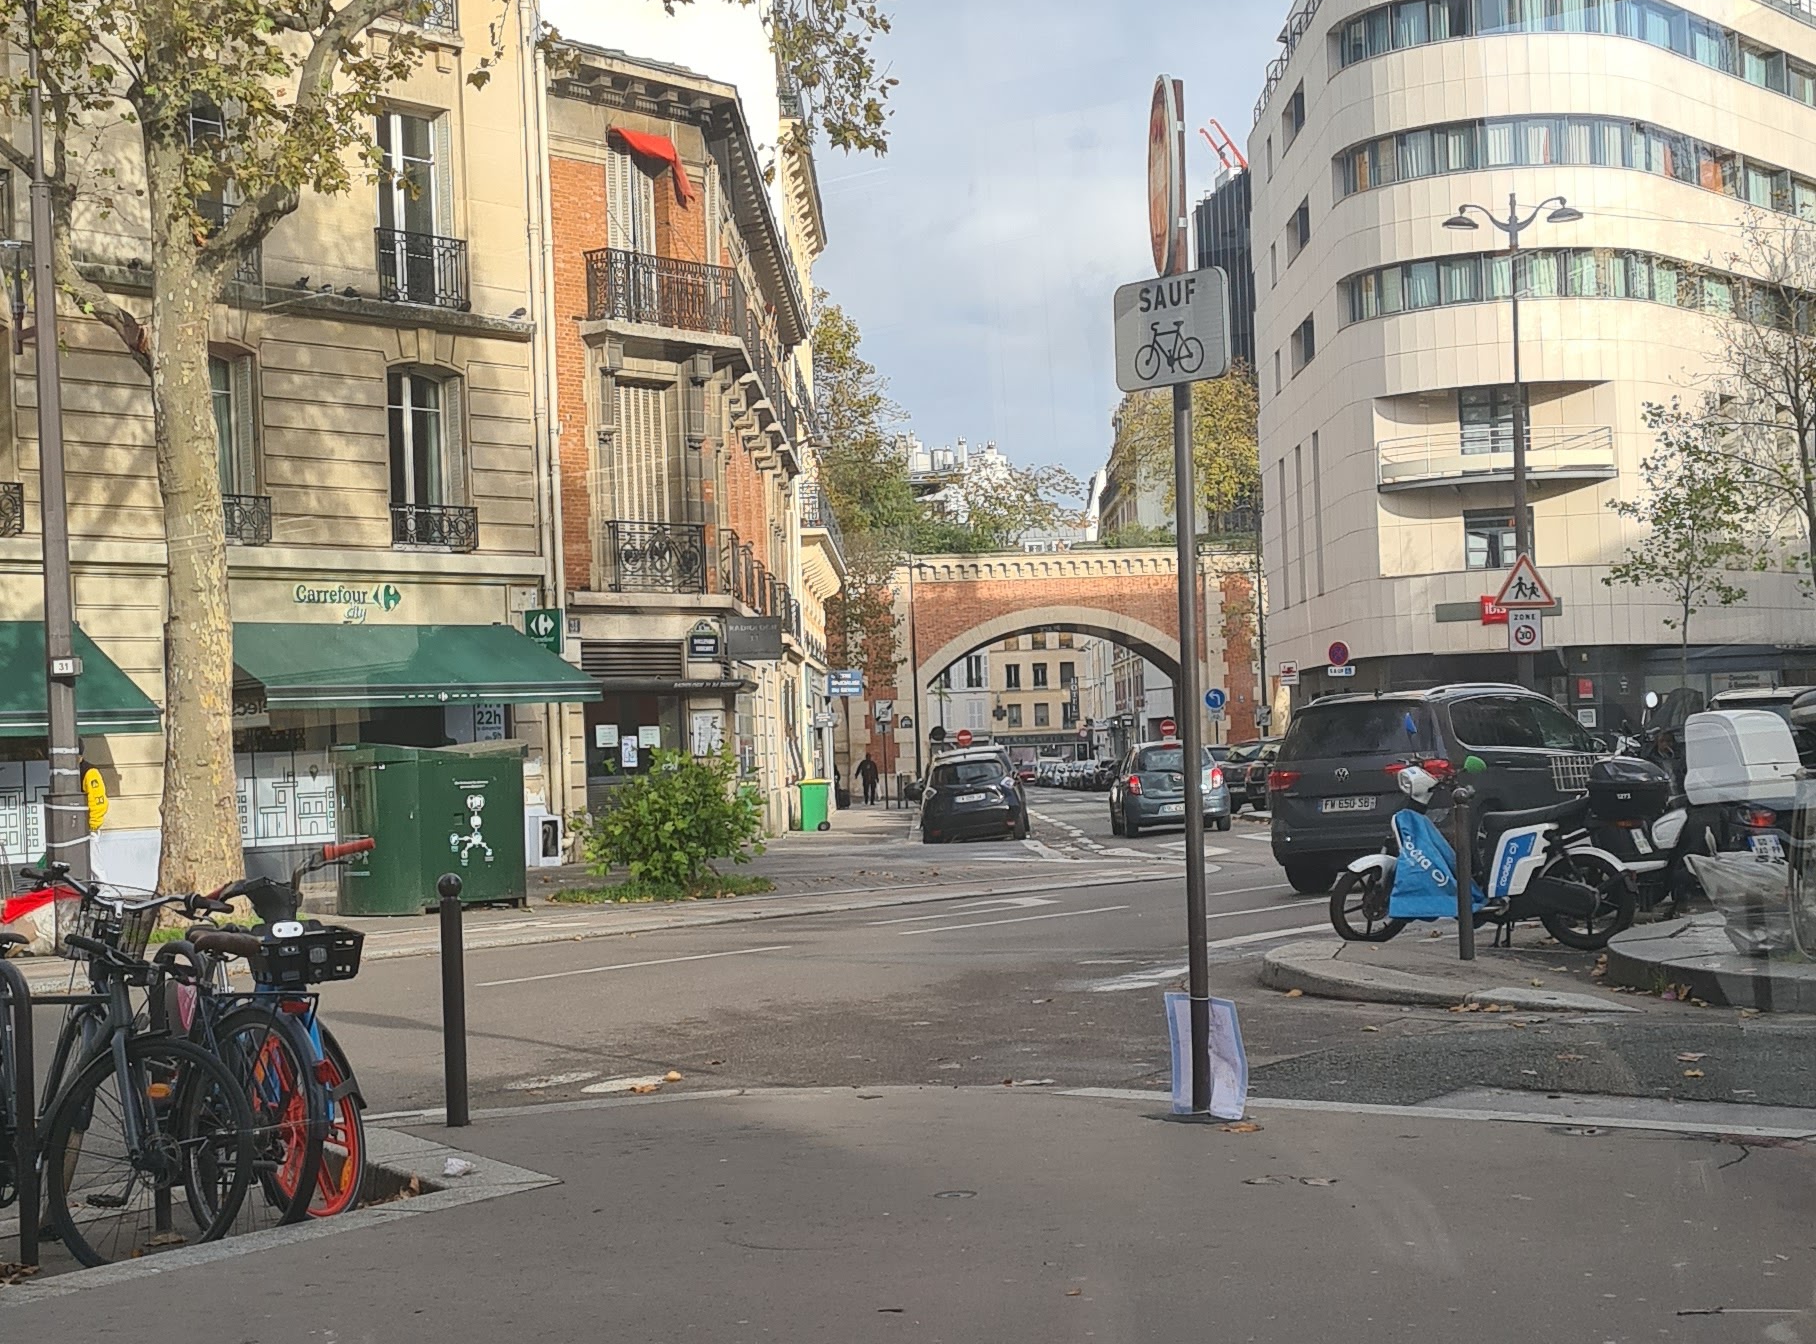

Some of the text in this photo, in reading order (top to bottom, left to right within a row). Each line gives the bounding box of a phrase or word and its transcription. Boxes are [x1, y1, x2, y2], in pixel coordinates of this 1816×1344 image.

[1139, 278, 1196, 313] SAUF
[296, 584, 368, 604] Carrefour
[346, 606, 367, 624] city
[1519, 630, 1532, 640] 30
[58, 662, 69, 671] 31
[1070, 676, 1078, 712] HOTEL
[476, 710, 502, 725] 22h
[1500, 856, 1514, 886] cooltra
